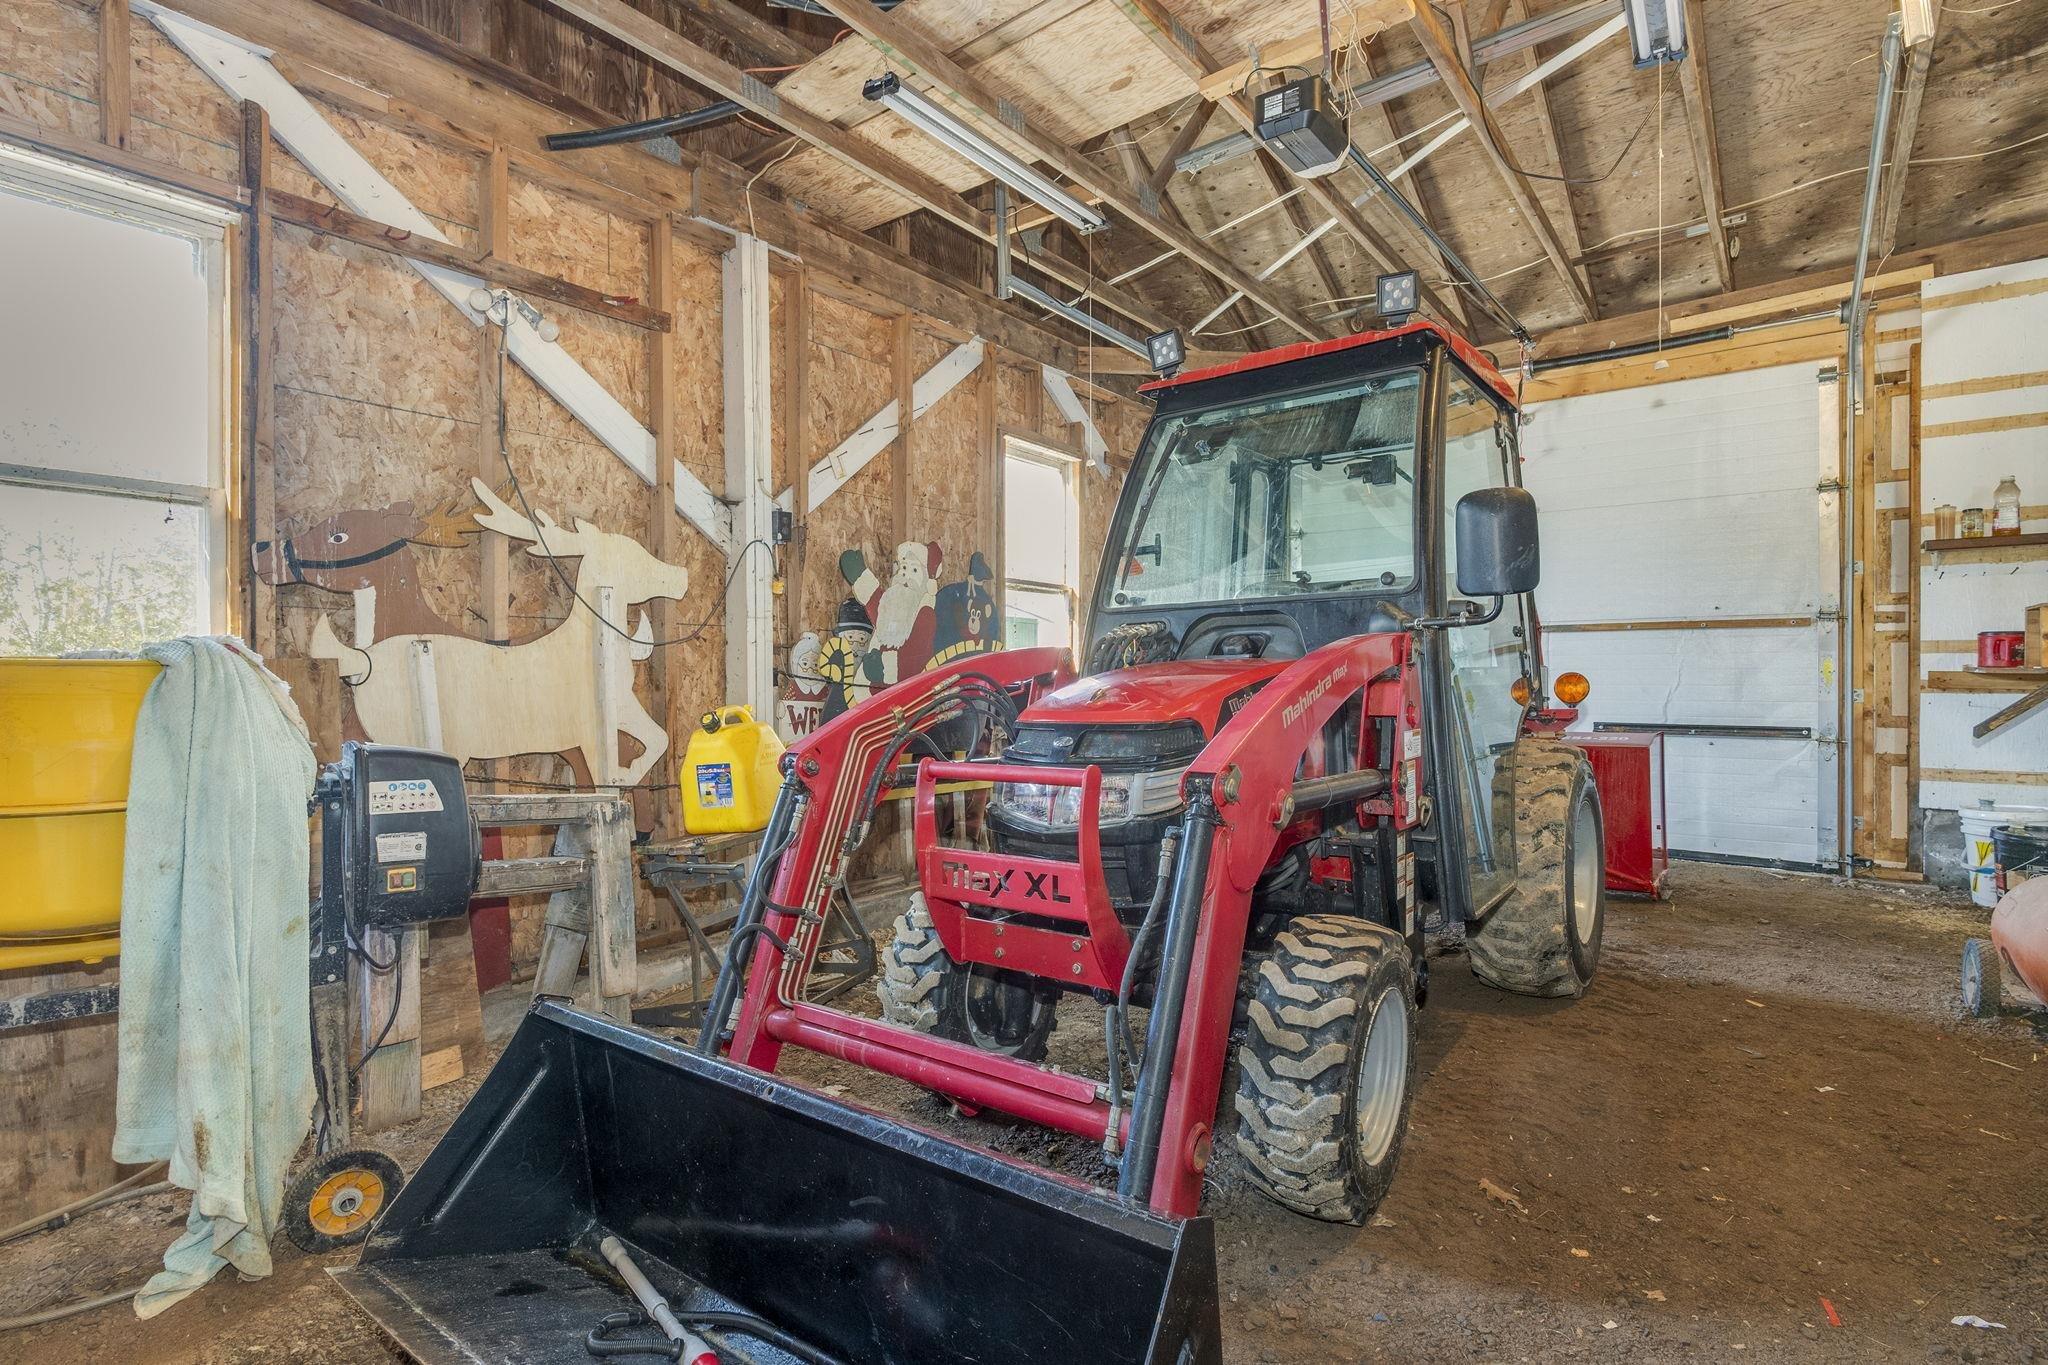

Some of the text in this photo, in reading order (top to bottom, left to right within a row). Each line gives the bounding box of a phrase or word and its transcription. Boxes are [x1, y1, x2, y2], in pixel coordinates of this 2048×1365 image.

[1282, 660, 1348, 729] Mahindra Max
[942, 861, 1071, 904] Max XL
